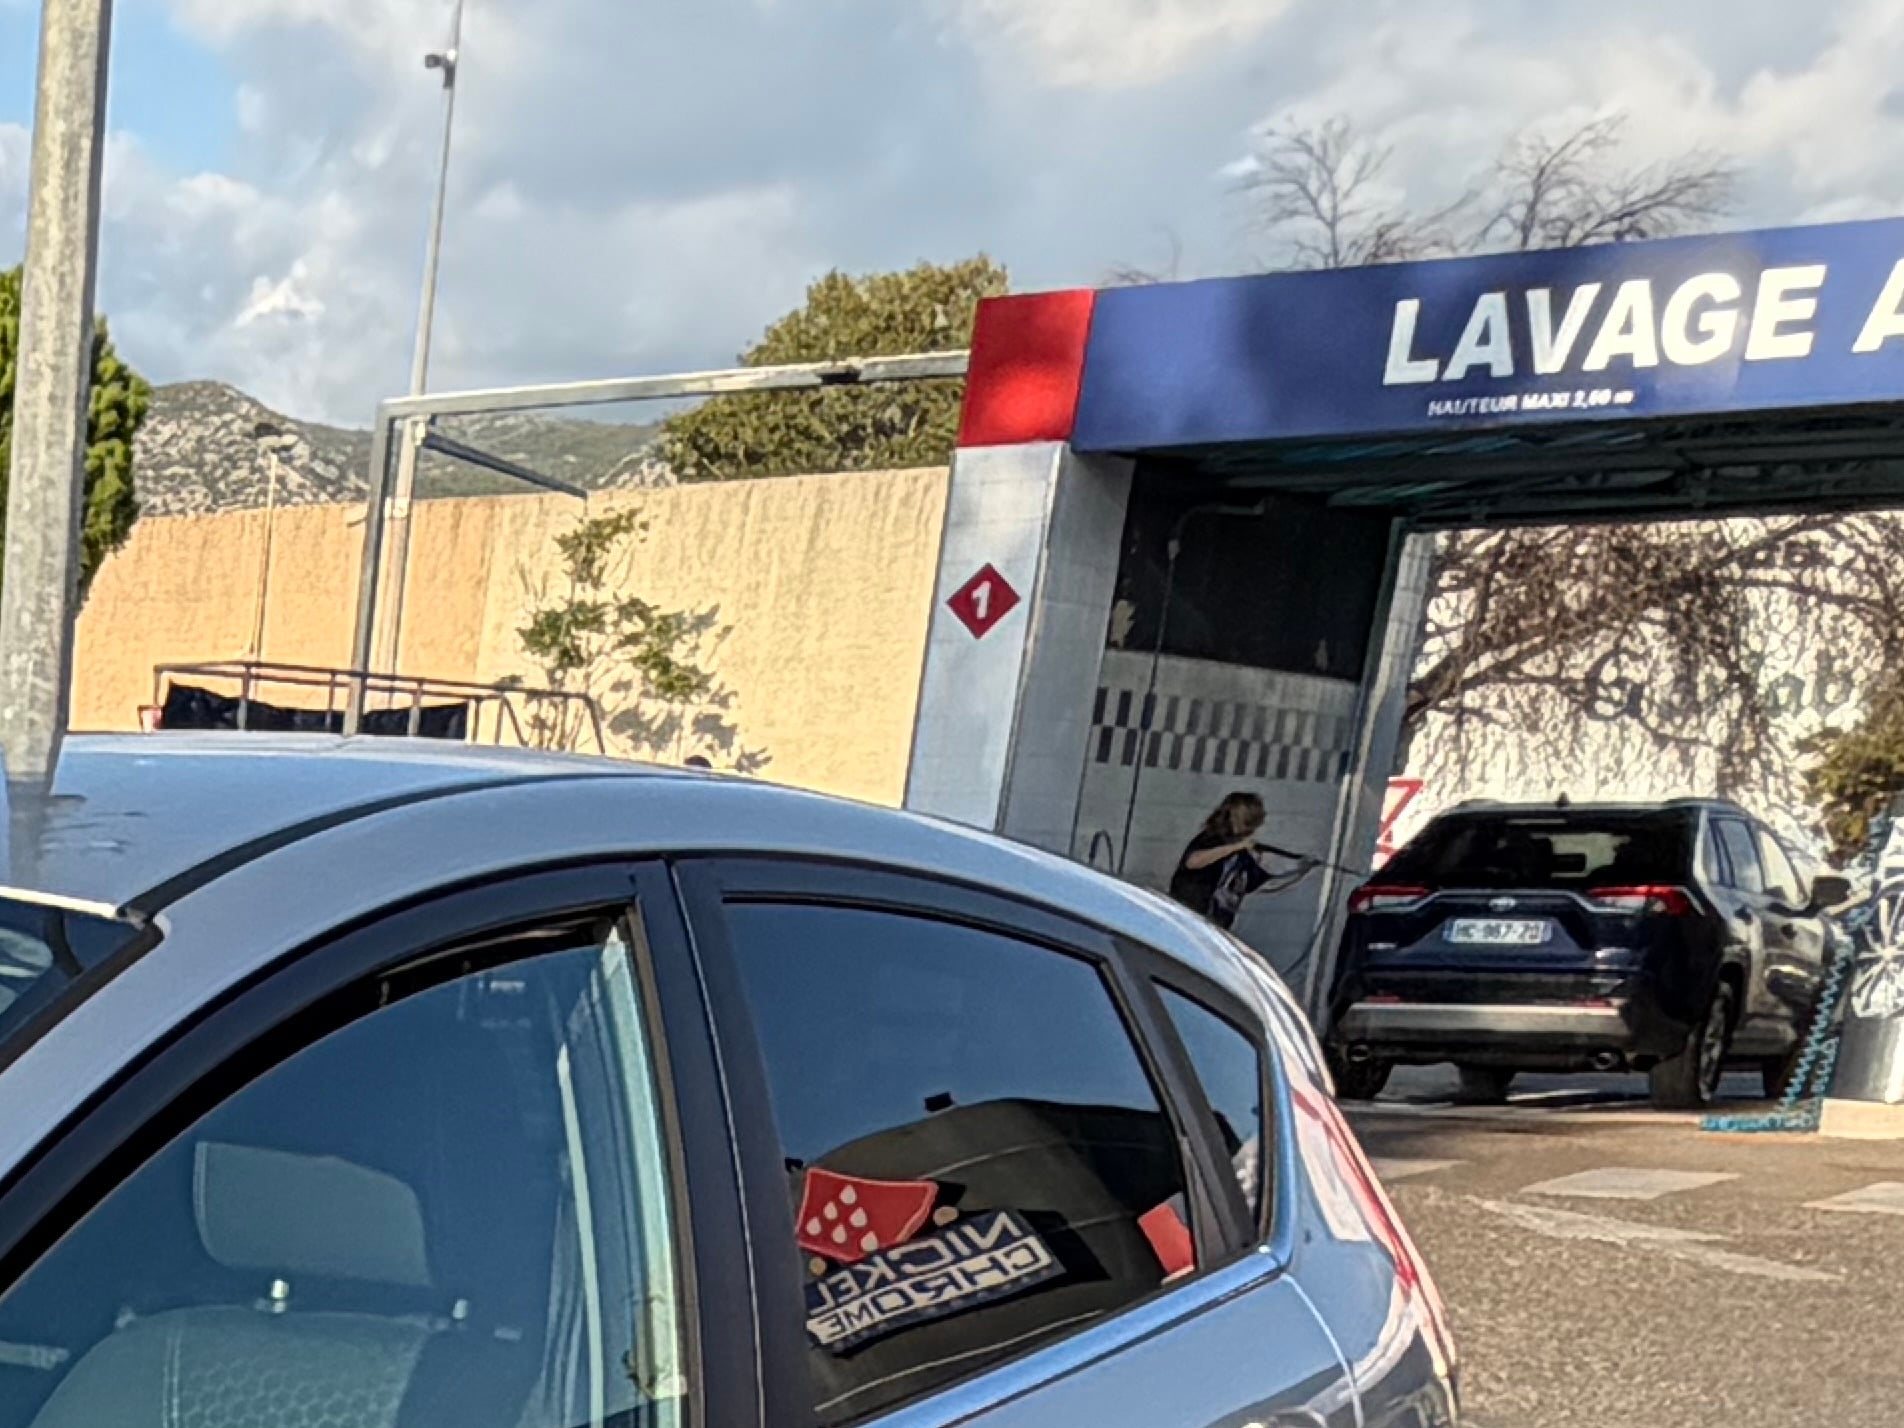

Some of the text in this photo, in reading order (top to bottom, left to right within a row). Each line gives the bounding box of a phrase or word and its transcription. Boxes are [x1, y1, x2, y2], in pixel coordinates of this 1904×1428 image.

[1382, 265, 1827, 385] LAVAGE
[1427, 395, 1518, 416] HAUTEUR
[971, 580, 992, 620] 1
